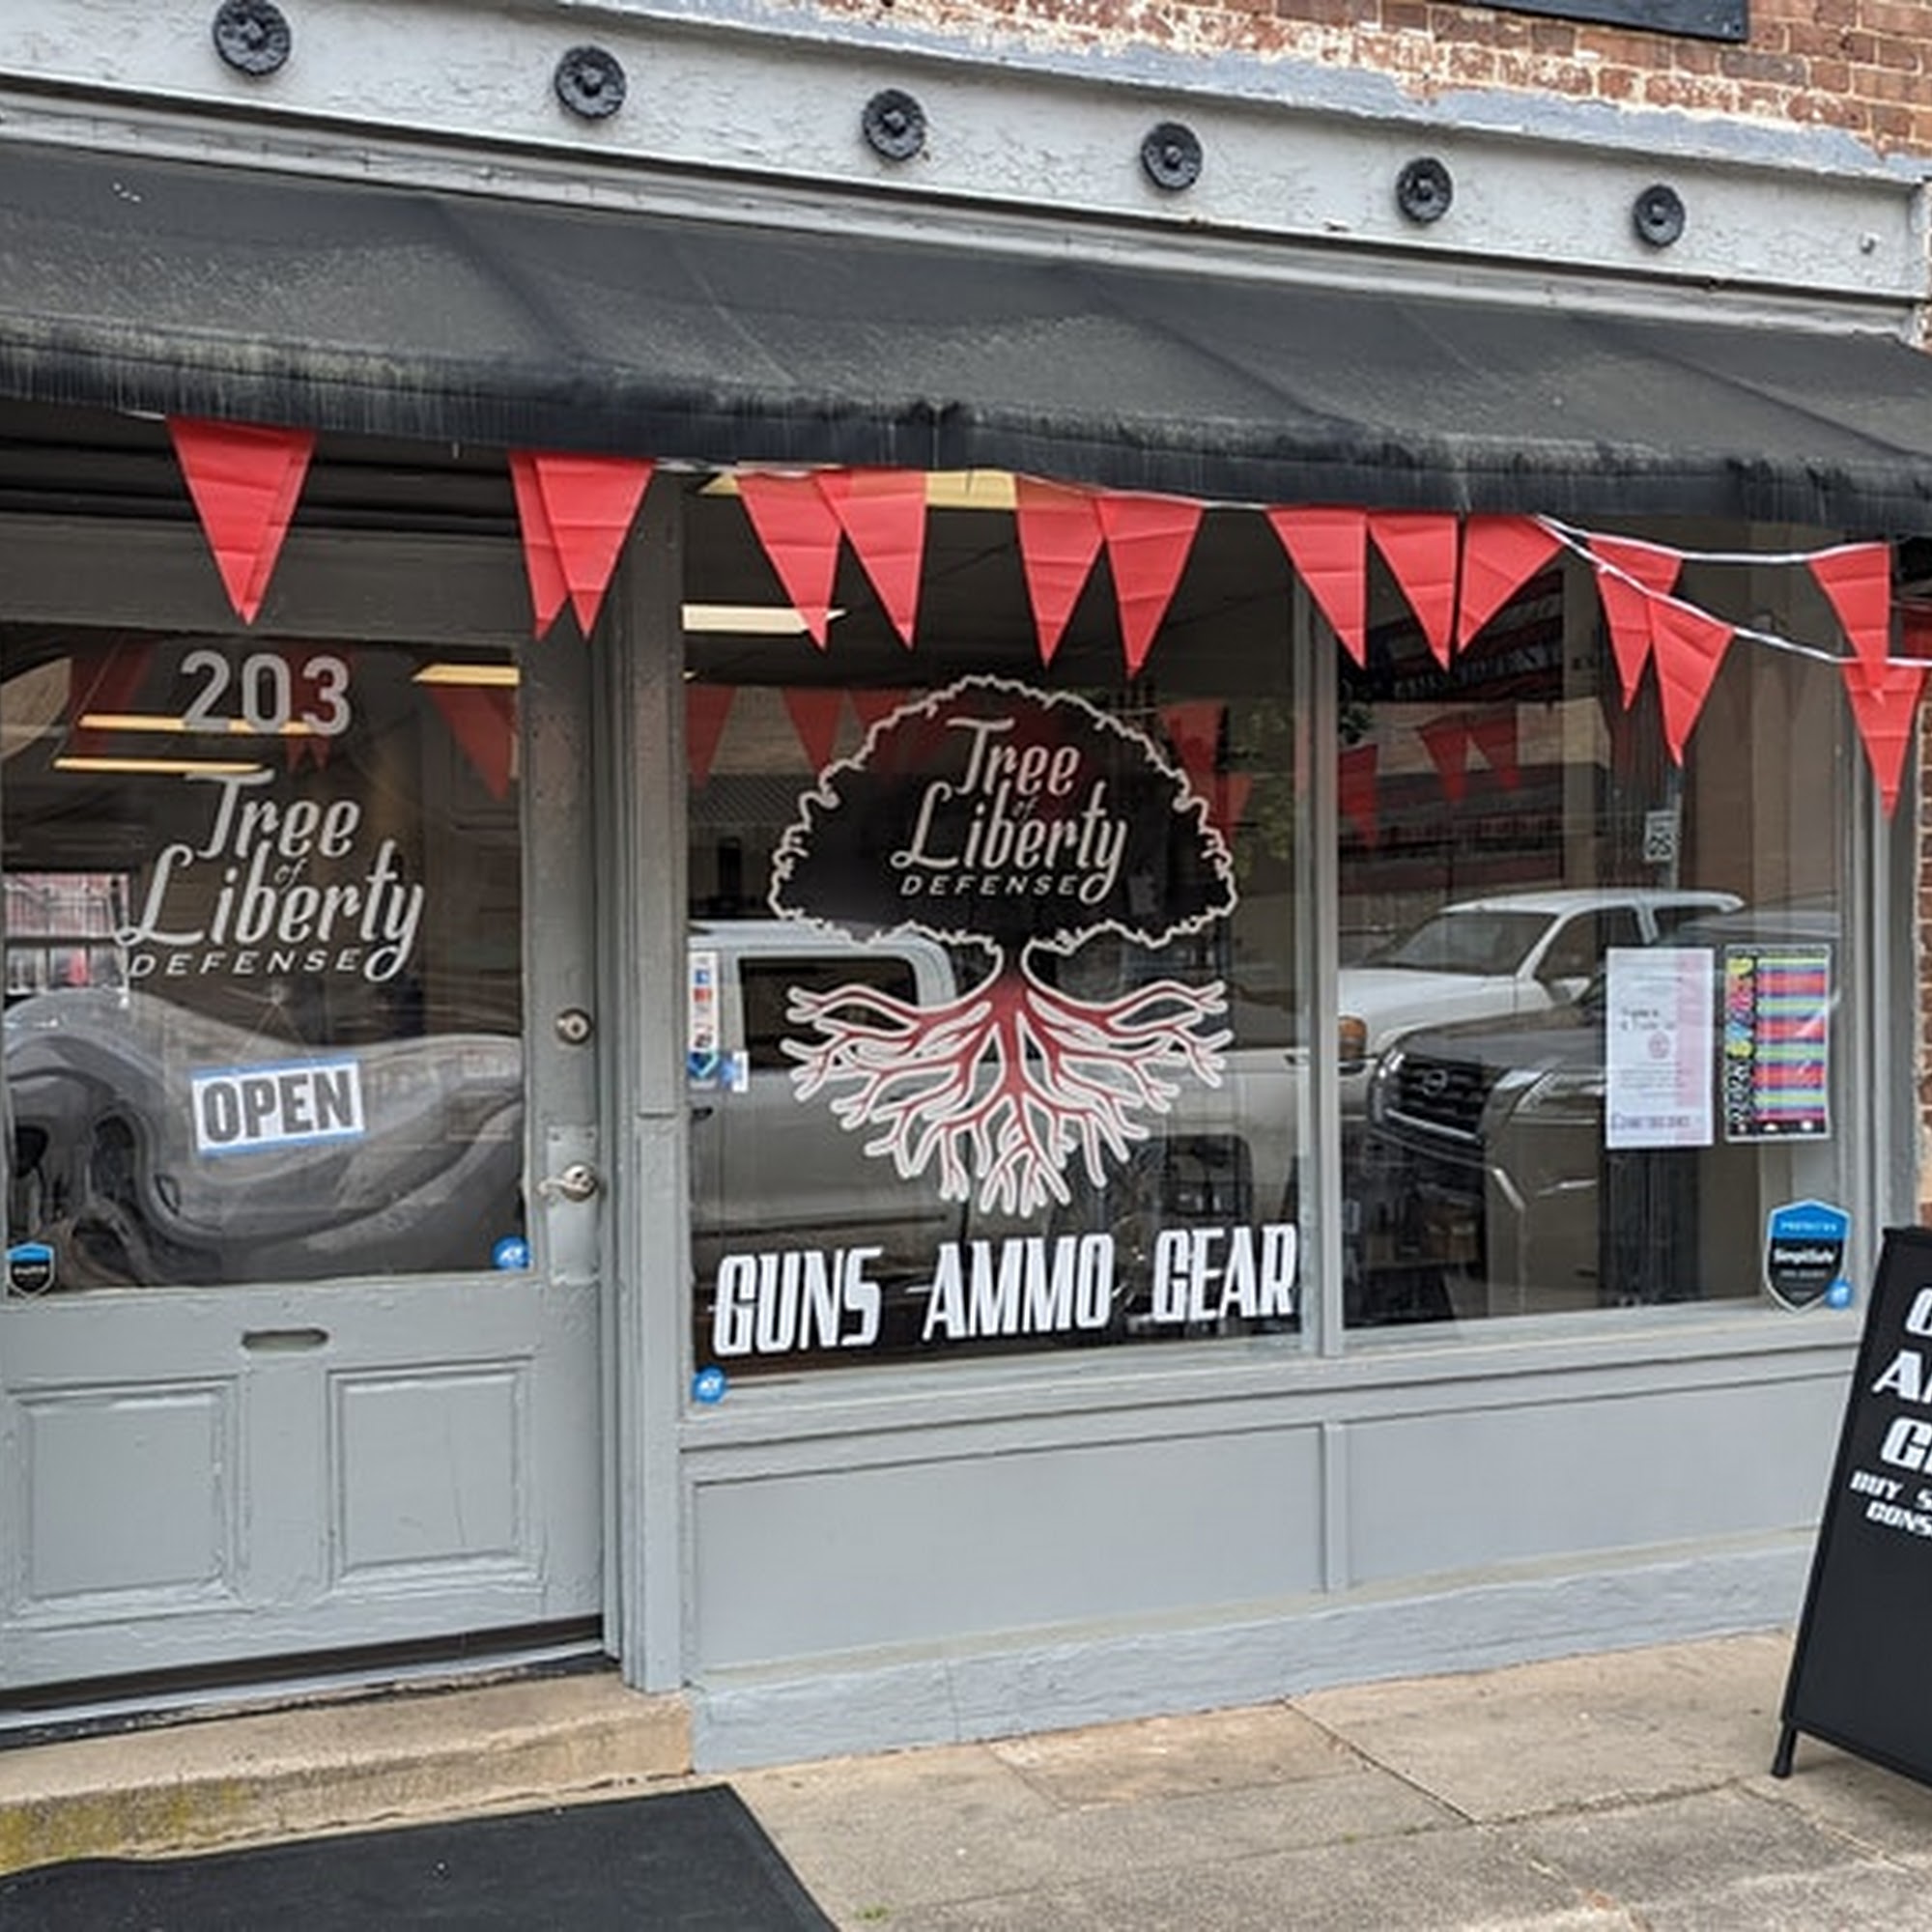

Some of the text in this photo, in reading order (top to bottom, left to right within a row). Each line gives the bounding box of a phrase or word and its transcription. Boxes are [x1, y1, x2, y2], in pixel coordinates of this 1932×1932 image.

[182, 651, 351, 734] 203
[946, 718, 1080, 795] Tree
[185, 770, 360, 858] Tree
[890, 780, 1127, 903] Liberty
[114, 839, 424, 981] Liberty
[274, 858, 307, 892] of
[900, 874, 1078, 895] DEFENSE
[129, 949, 361, 978] DEFENSE
[202, 1069, 354, 1143] OPEN
[713, 1224, 1297, 1354] GUNS AMMO GEAR
[1872, 1350, 1932, 1404] A
[1880, 1415, 1932, 1474] G
